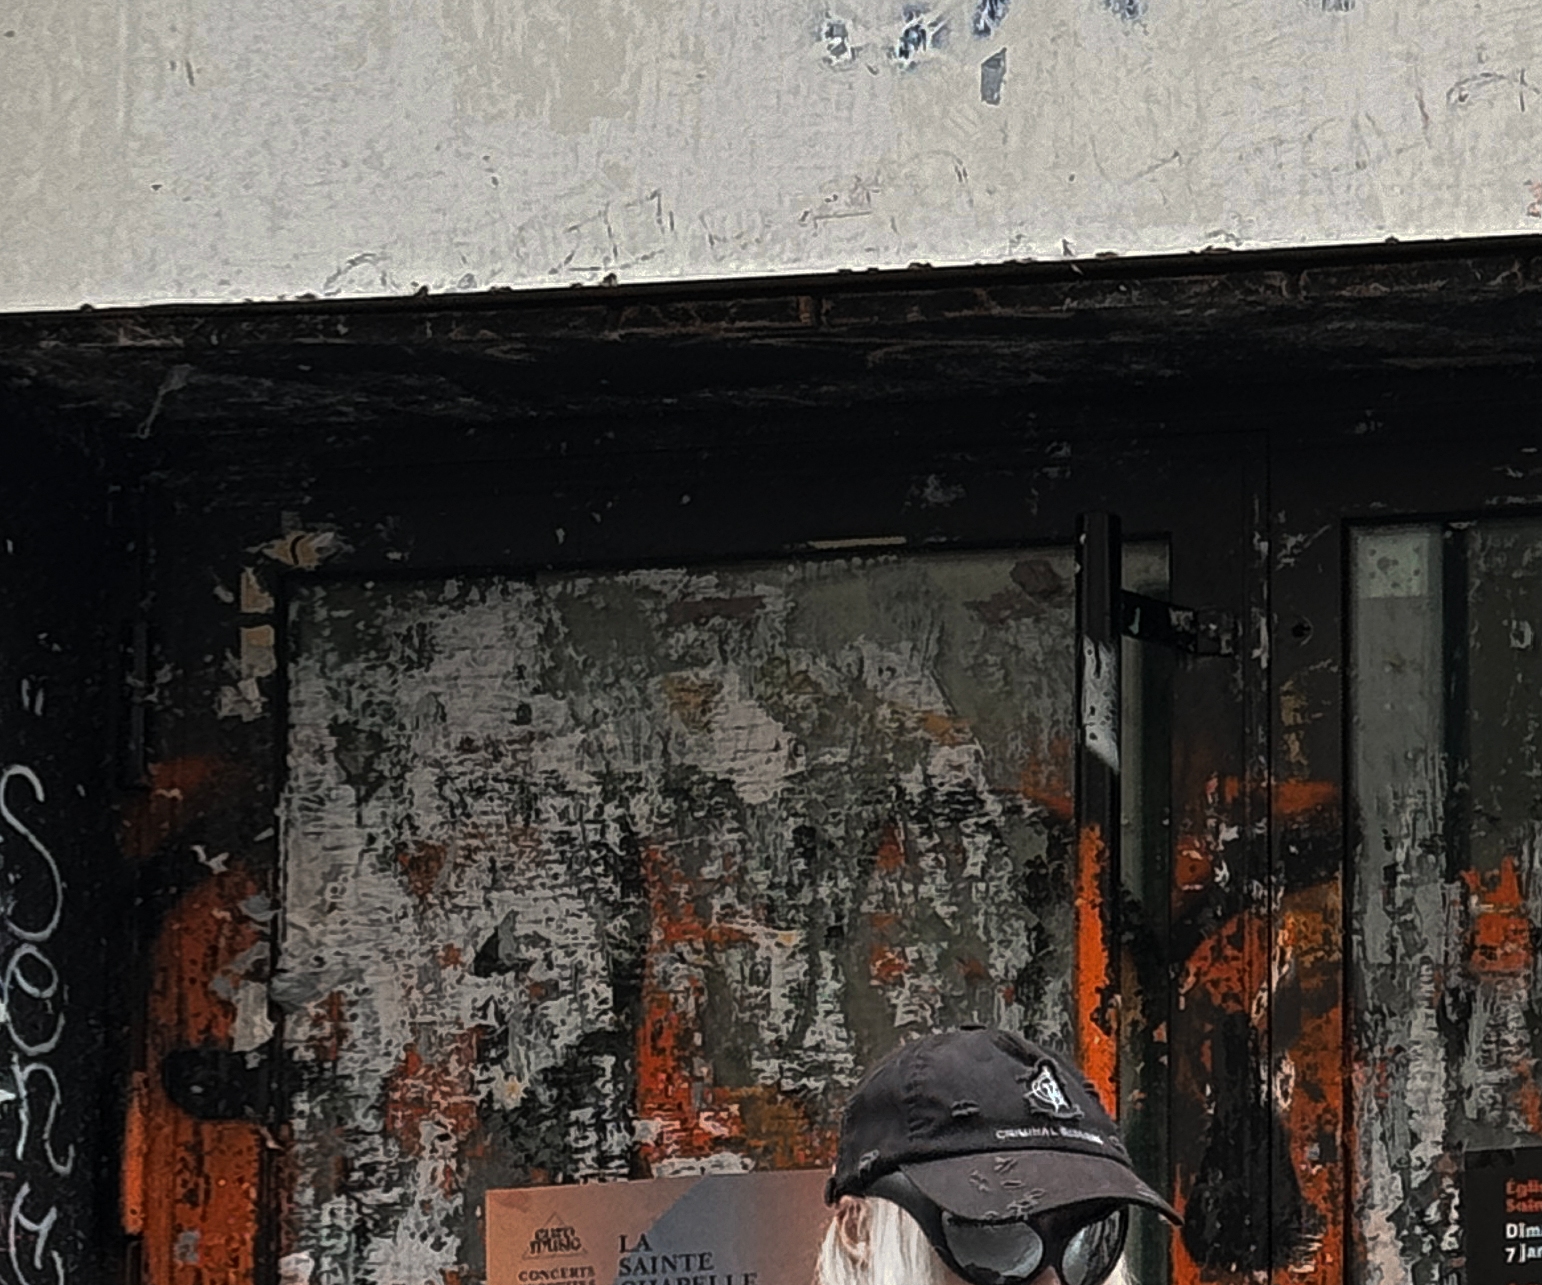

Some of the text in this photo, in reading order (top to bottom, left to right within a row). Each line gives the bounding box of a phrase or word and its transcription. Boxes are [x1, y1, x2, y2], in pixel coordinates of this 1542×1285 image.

[618, 1233, 653, 1254] LA
[618, 1251, 715, 1277] SAINTE
[1505, 1247, 1517, 1263] 7
[518, 1266, 596, 1282] CONCERTS
